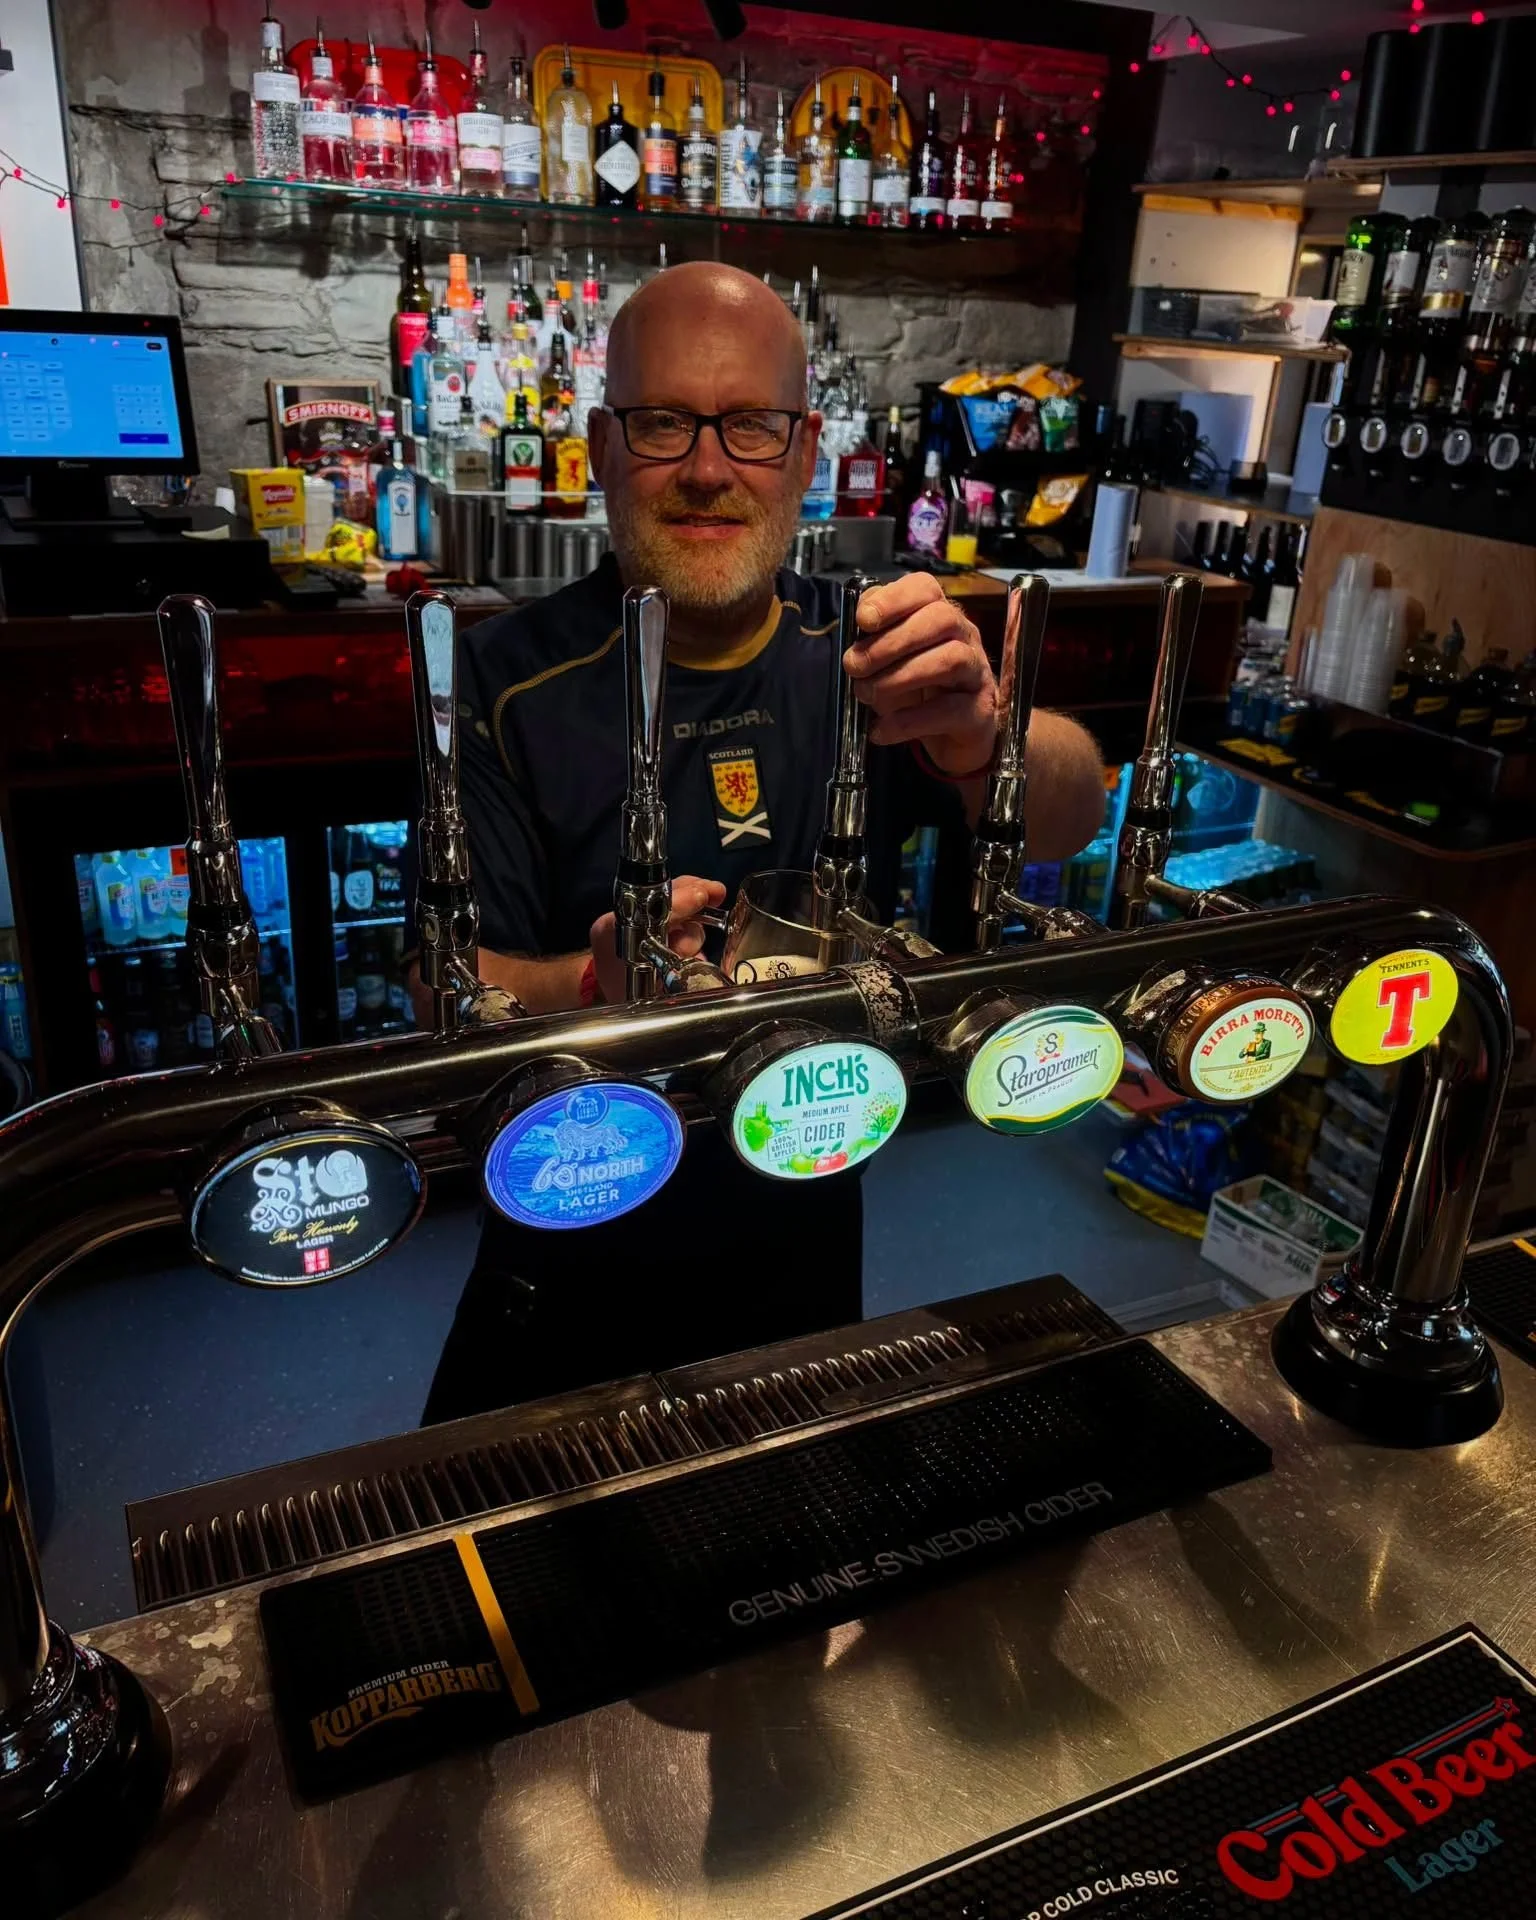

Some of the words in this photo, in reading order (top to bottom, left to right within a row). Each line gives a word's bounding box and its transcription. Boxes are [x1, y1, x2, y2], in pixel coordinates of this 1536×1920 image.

[288, 403, 370, 420] SMIRNOFF
[673, 709, 775, 738] DIADORA
[708, 748, 754, 760] SCOTLAND
[1379, 959, 1430, 974] TENNENT'S
[1378, 970, 1431, 1049] T
[1200, 1014, 1249, 1057] BIRRA
[1253, 1008, 1305, 1040] MORETTI
[782, 1054, 869, 1107] INCH'S
[996, 1048, 1099, 1107] Staropramen
[1228, 1064, 1273, 1080] L'AUTENTICA
[802, 1107, 829, 1118] MEDIUM
[830, 1104, 850, 1115] APPLE
[771, 1140, 797, 1152] BRITISH
[804, 1122, 845, 1143] CIDER
[773, 1146, 797, 1158] APPLES
[578, 1157, 644, 1185] NORTH
[558, 1189, 620, 1212] LAGER
[565, 1182, 613, 1197] SHETLAND
[304, 1195, 370, 1219] MUNGO
[269, 1228, 299, 1246] Pure
[302, 1215, 359, 1238] Heavenly
[296, 1234, 334, 1249] LAGER
[728, 1561, 875, 1626] GENUINE
[874, 1512, 1025, 1576] SWEDISH
[1024, 1481, 1113, 1525] CIDER
[347, 1669, 407, 1699] PREMIUM
[410, 1660, 449, 1676] CIDER
[310, 1661, 502, 1752] KOPPARBERG
[1216, 1776, 1406, 1902] Cold
[1366, 1721, 1536, 1825] Beer
[1384, 1818, 1505, 1893] Lager
[1042, 1885, 1094, 1919] COLD
[1094, 1868, 1180, 1897] CLASSIC
